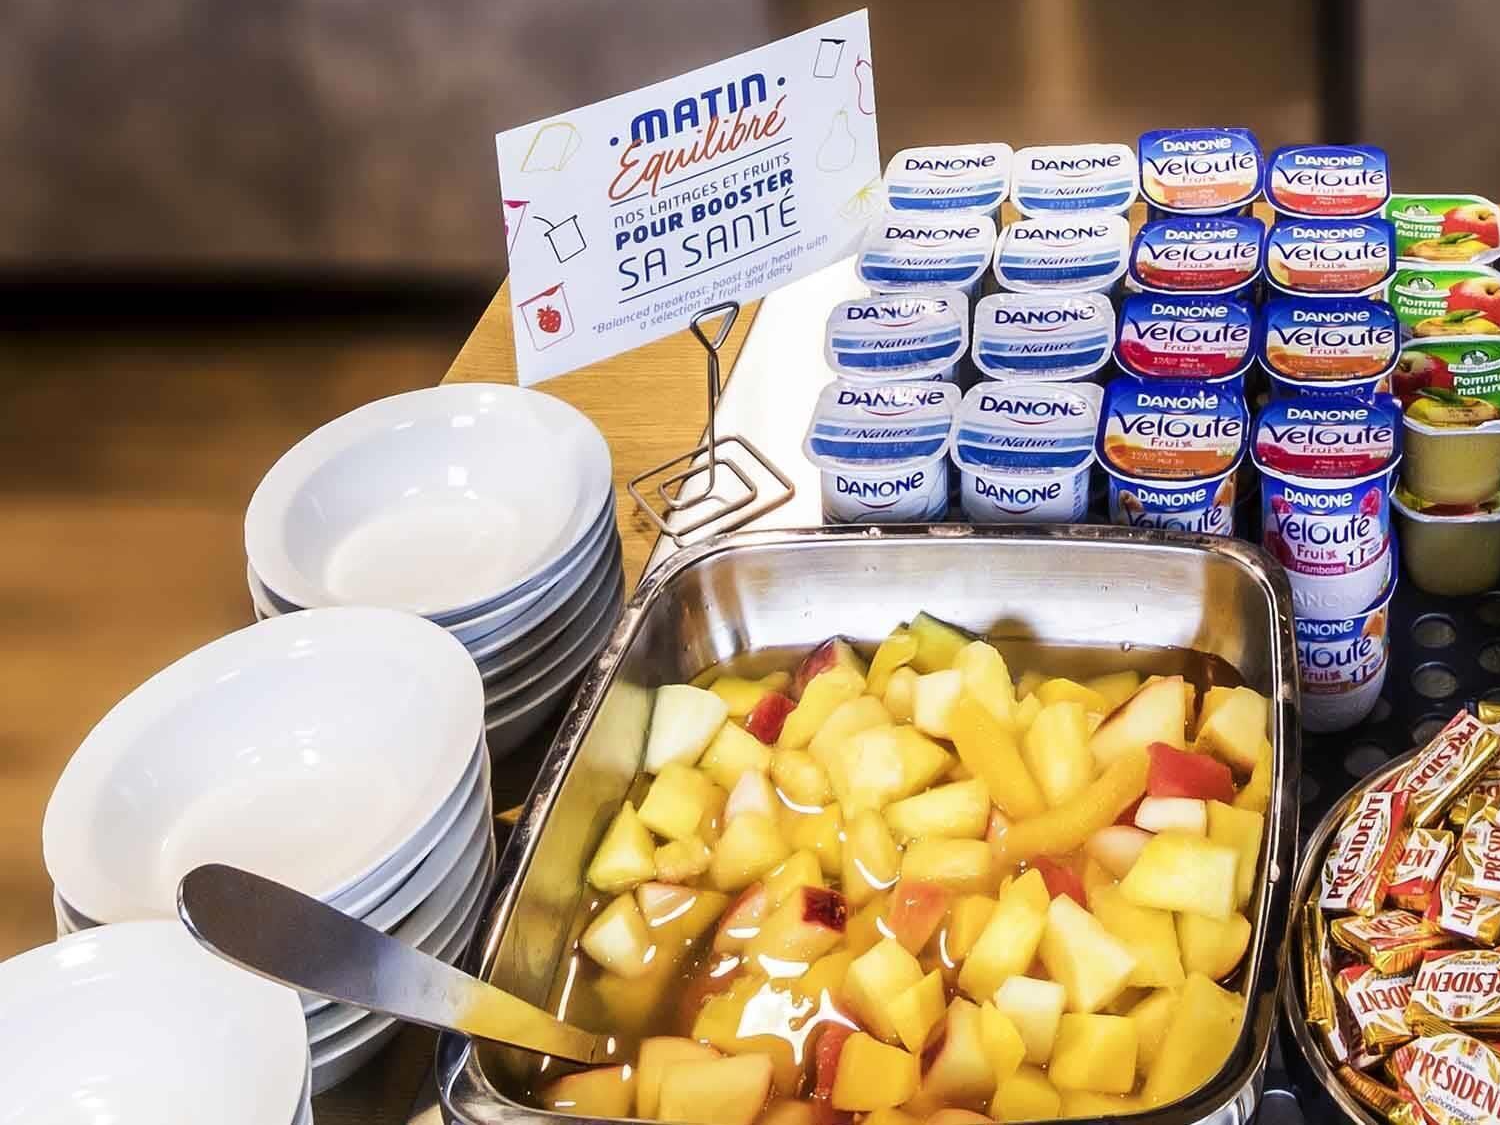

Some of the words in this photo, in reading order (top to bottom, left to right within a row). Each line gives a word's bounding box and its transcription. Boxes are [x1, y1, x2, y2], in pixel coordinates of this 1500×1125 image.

[631, 73, 767, 148] MATIN
[608, 94, 787, 201] Equilibré
[1163, 138, 1232, 153] DANONE
[905, 155, 996, 170] DANONE
[1031, 155, 1121, 170] DANONE
[1146, 153, 1255, 177] Velouté
[1294, 154, 1364, 167] DANONE
[1280, 167, 1384, 187] Velouté
[614, 209, 645, 229] NOS
[650, 181, 718, 217] LAITAGES
[723, 173, 739, 190] ET
[744, 152, 791, 182] FRUITS
[615, 212, 684, 251] POUR
[691, 168, 795, 224] BOOSTER
[618, 247, 667, 292] SA
[682, 187, 797, 268] SANTÉ
[1015, 225, 1109, 240] DANONE
[712, 272, 743, 289] boost
[745, 259, 769, 278] your
[771, 243, 805, 266] health
[806, 234, 829, 251] with
[651, 301, 702, 328] selection
[718, 284, 742, 303] fruit
[744, 274, 765, 290] and
[766, 263, 793, 284] dairy
[1397, 296, 1448, 309] Pomme
[995, 306, 1096, 325] DANONE
[1151, 305, 1227, 318] DANONE
[1294, 310, 1370, 323] DANONE
[1399, 306, 1446, 316] nature
[1127, 319, 1248, 344] Velouté
[1267, 324, 1393, 347] Velouté
[1022, 339, 1074, 353] Nature
[980, 396, 1086, 416] DANONE
[1137, 394, 1217, 410] DANONE
[1114, 409, 1241, 439] Velouté
[1287, 408, 1368, 422] DANONE
[1000, 433, 1059, 448] Nature
[1264, 423, 1392, 445] Velouté
[836, 472, 925, 496] DANONE
[975, 481, 1062, 503] DANONE
[1137, 489, 1206, 505] DANONE
[1284, 487, 1353, 508] DANONE
[1274, 514, 1370, 545] Velouté
[1296, 562, 1344, 575] Framboise
[1326, 794, 1384, 900] PRÉSIDENT
